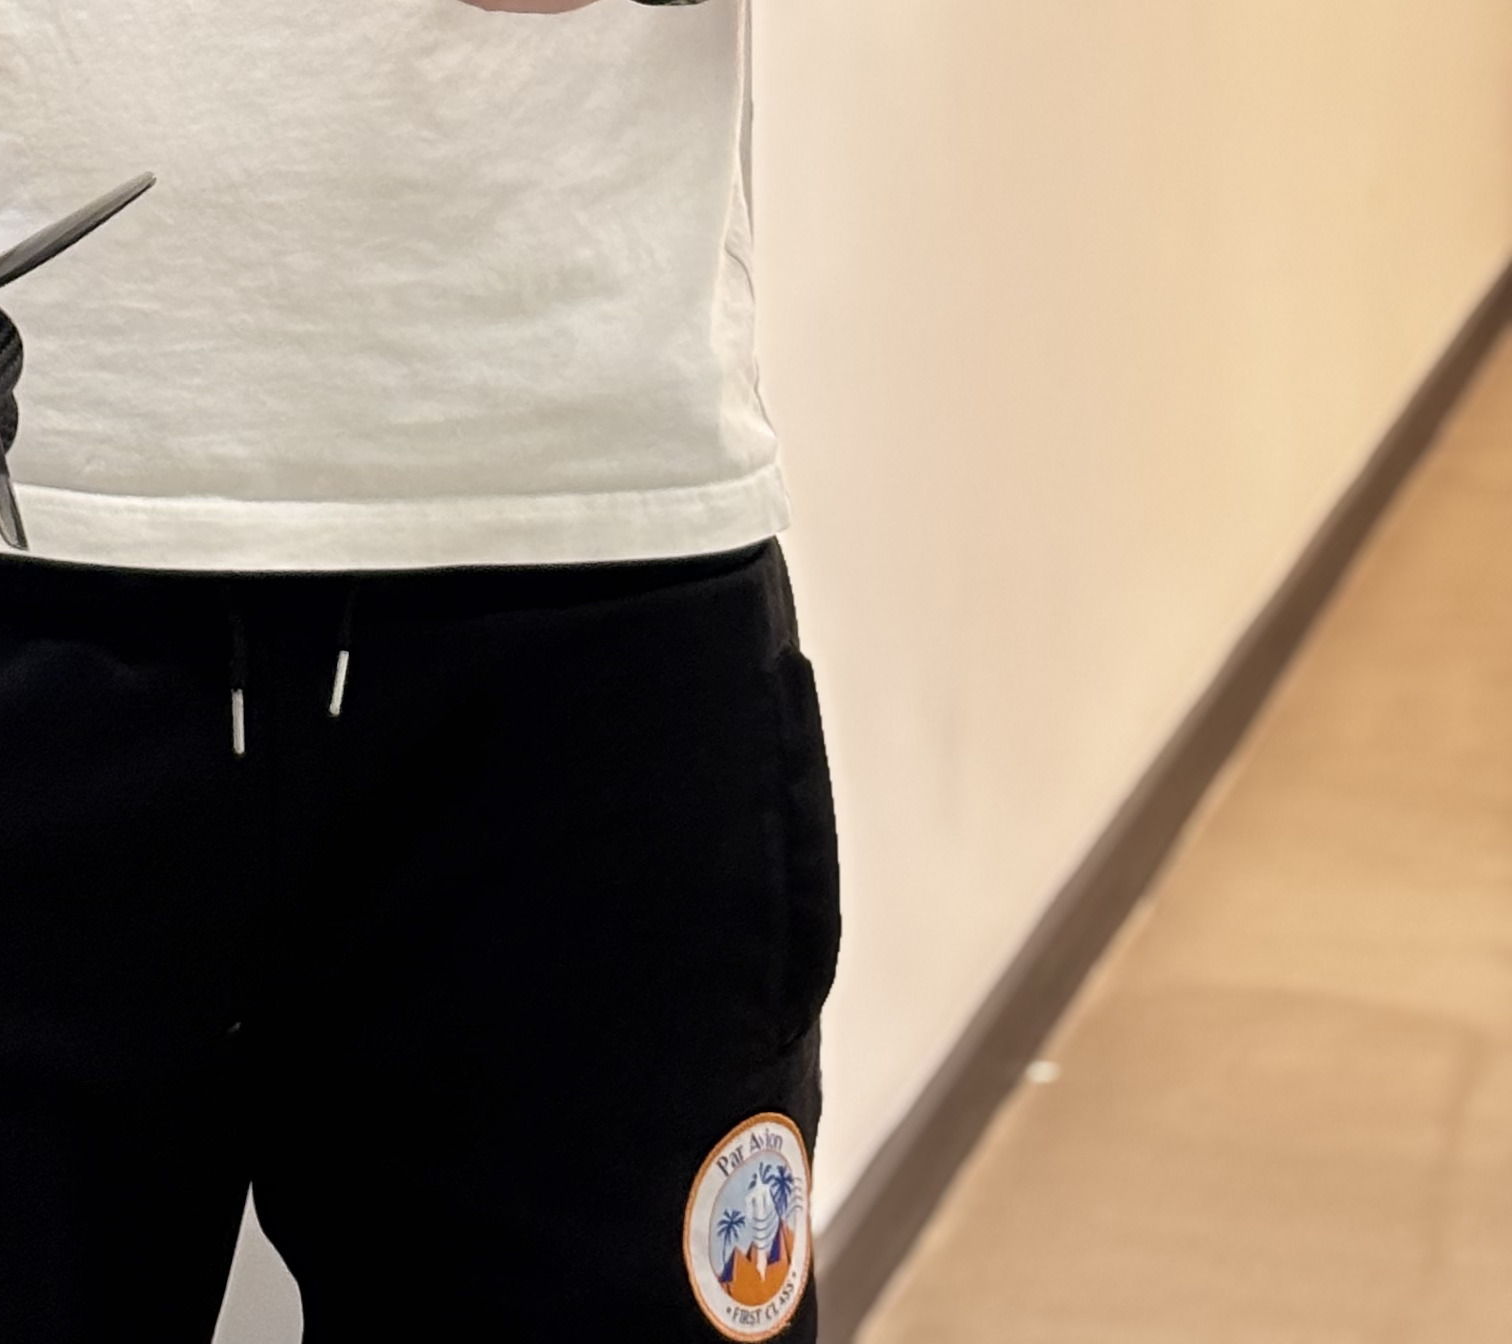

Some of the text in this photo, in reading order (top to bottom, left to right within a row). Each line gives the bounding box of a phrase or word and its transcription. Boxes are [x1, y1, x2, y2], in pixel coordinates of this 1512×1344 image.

[716, 1127, 784, 1177] Par Avion
[731, 1306, 762, 1327] FIRST
